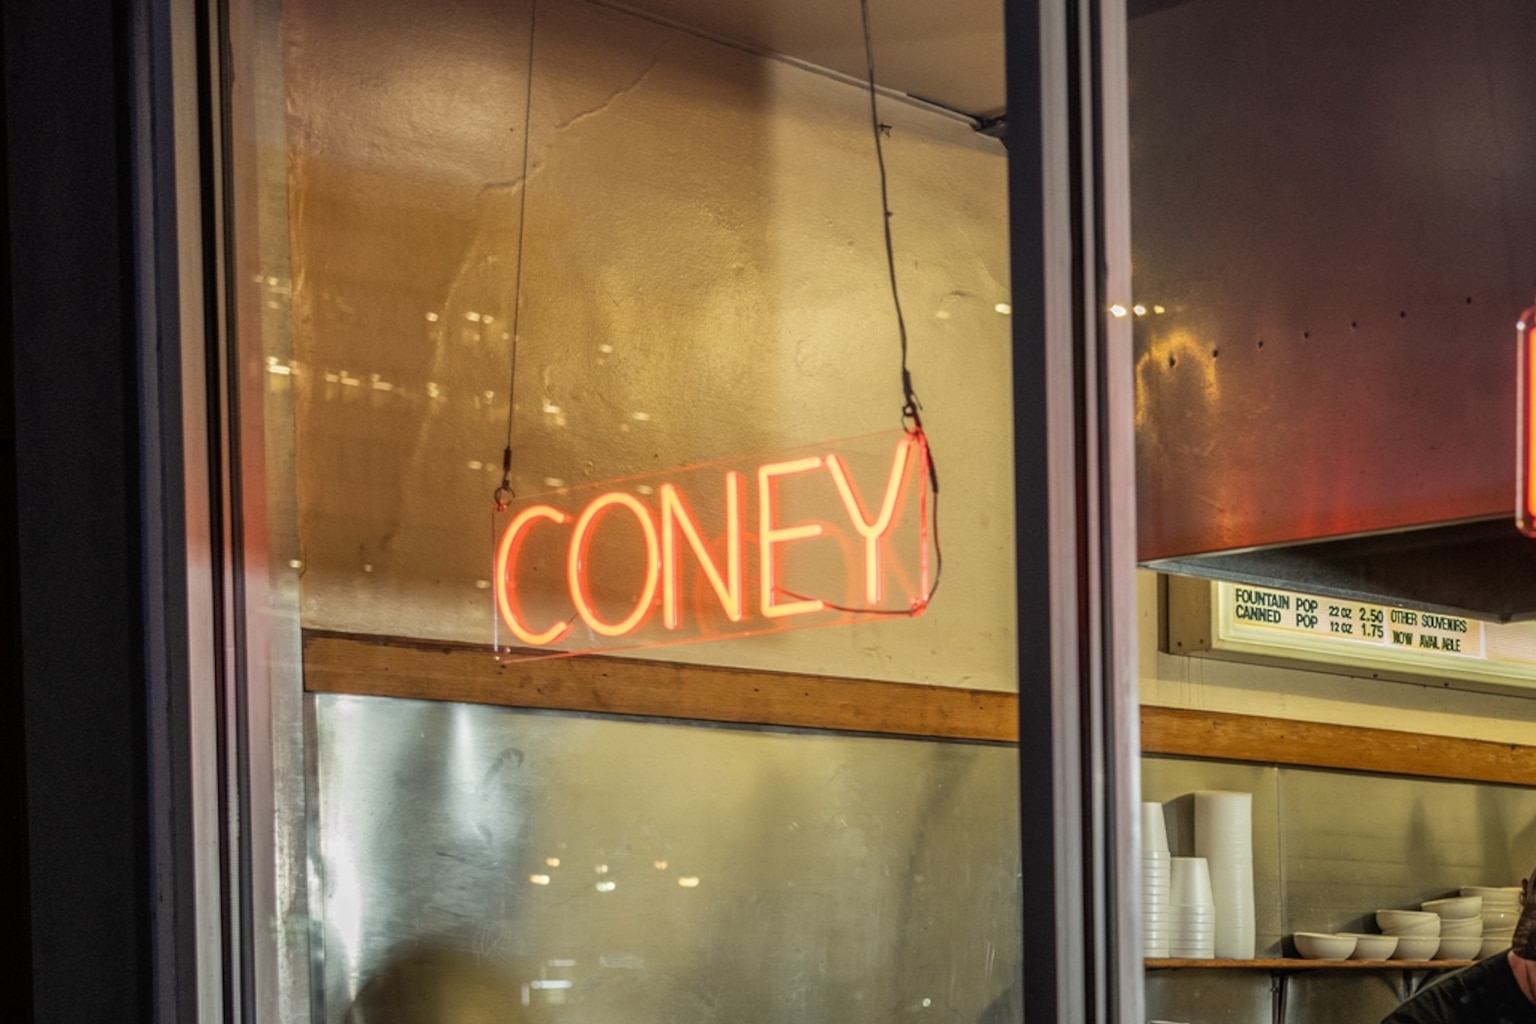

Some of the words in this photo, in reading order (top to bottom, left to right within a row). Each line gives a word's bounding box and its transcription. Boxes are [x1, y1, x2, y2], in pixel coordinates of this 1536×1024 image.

[497, 438, 914, 646] CONEY
[1235, 588, 1290, 610] FOUNTAIN
[1296, 598, 1318, 614] POP
[1359, 607, 1384, 624] 2.50
[1235, 604, 1281, 624] CANNED
[1296, 613, 1318, 629] POP
[1361, 623, 1384, 638] 1.75
[1390, 609, 1418, 626] OTHER
[1421, 614, 1468, 633] SOUVENIRS
[1392, 630, 1413, 646] NOW
